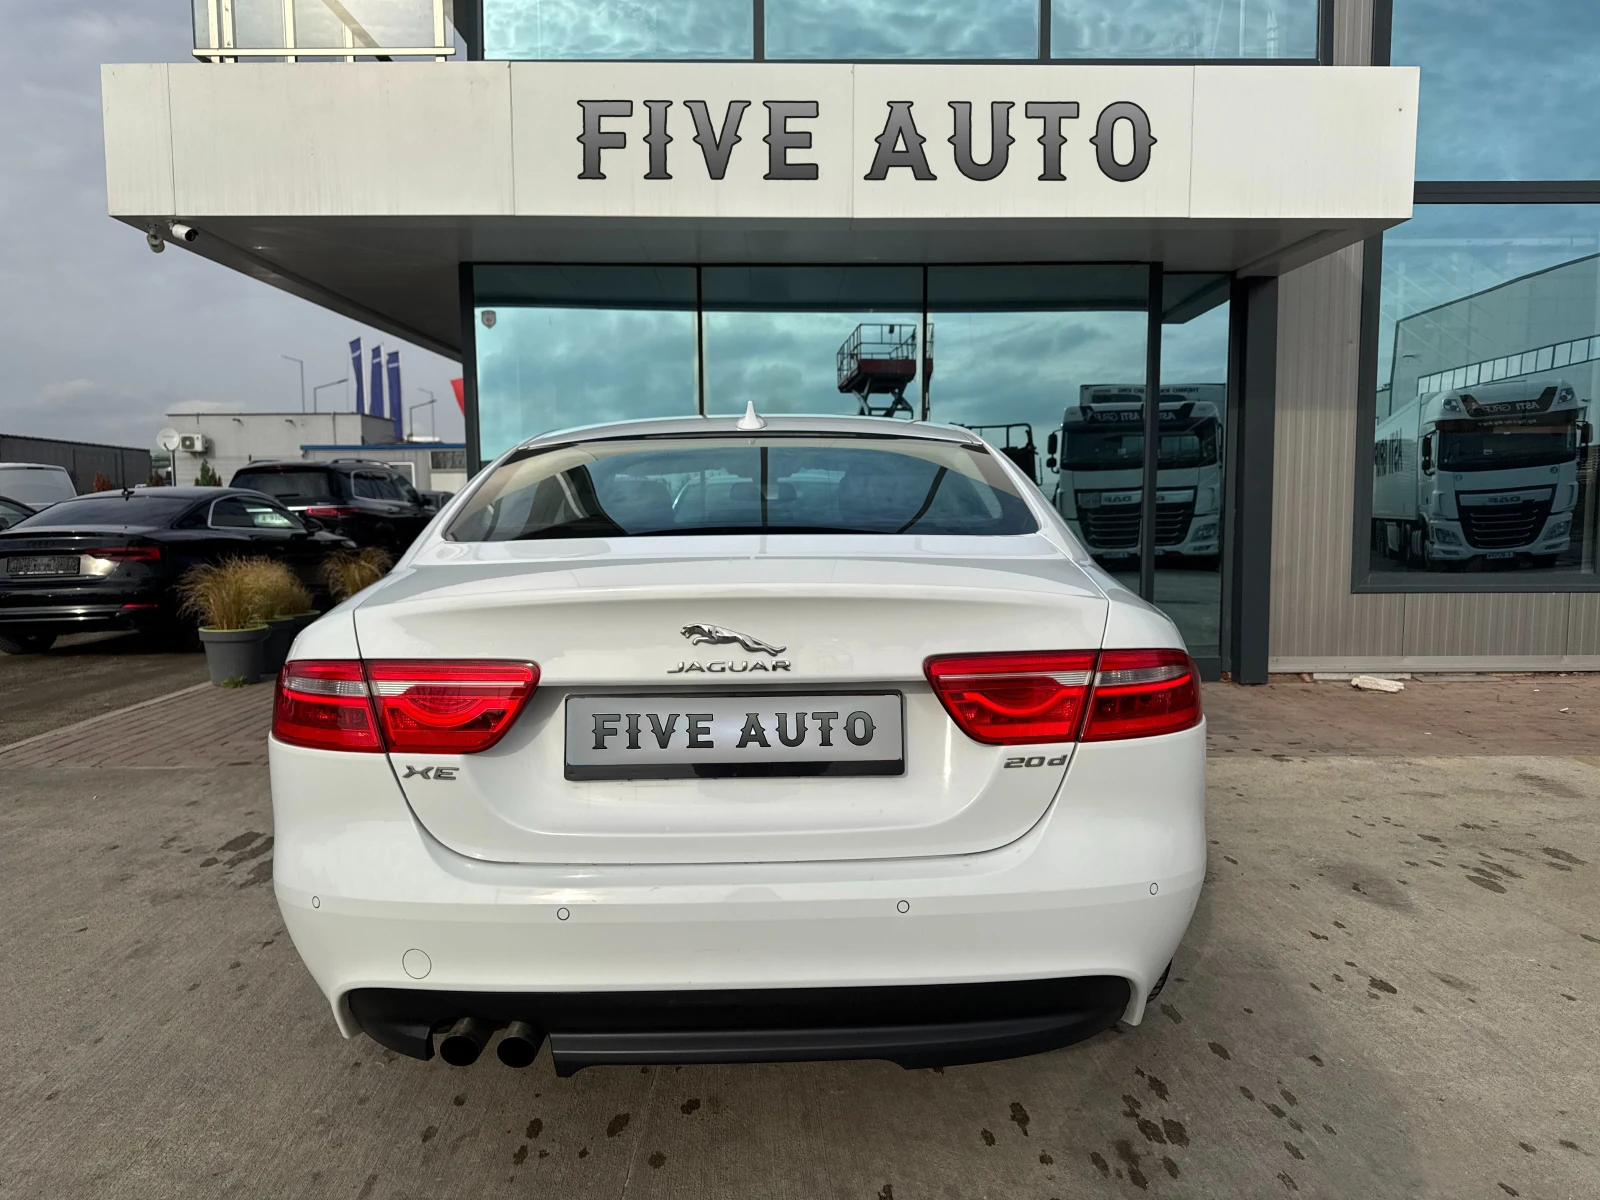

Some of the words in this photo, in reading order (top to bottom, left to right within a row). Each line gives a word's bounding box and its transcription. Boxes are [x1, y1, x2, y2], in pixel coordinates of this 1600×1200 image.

[577, 100, 819, 180] FIVE
[864, 101, 1157, 182] AUTO
[666, 659, 791, 674] JAGUAR
[591, 713, 714, 750] FIVE
[736, 710, 876, 748] AUTO
[1003, 754, 1068, 768] 20d
[402, 765, 460, 780] XE
